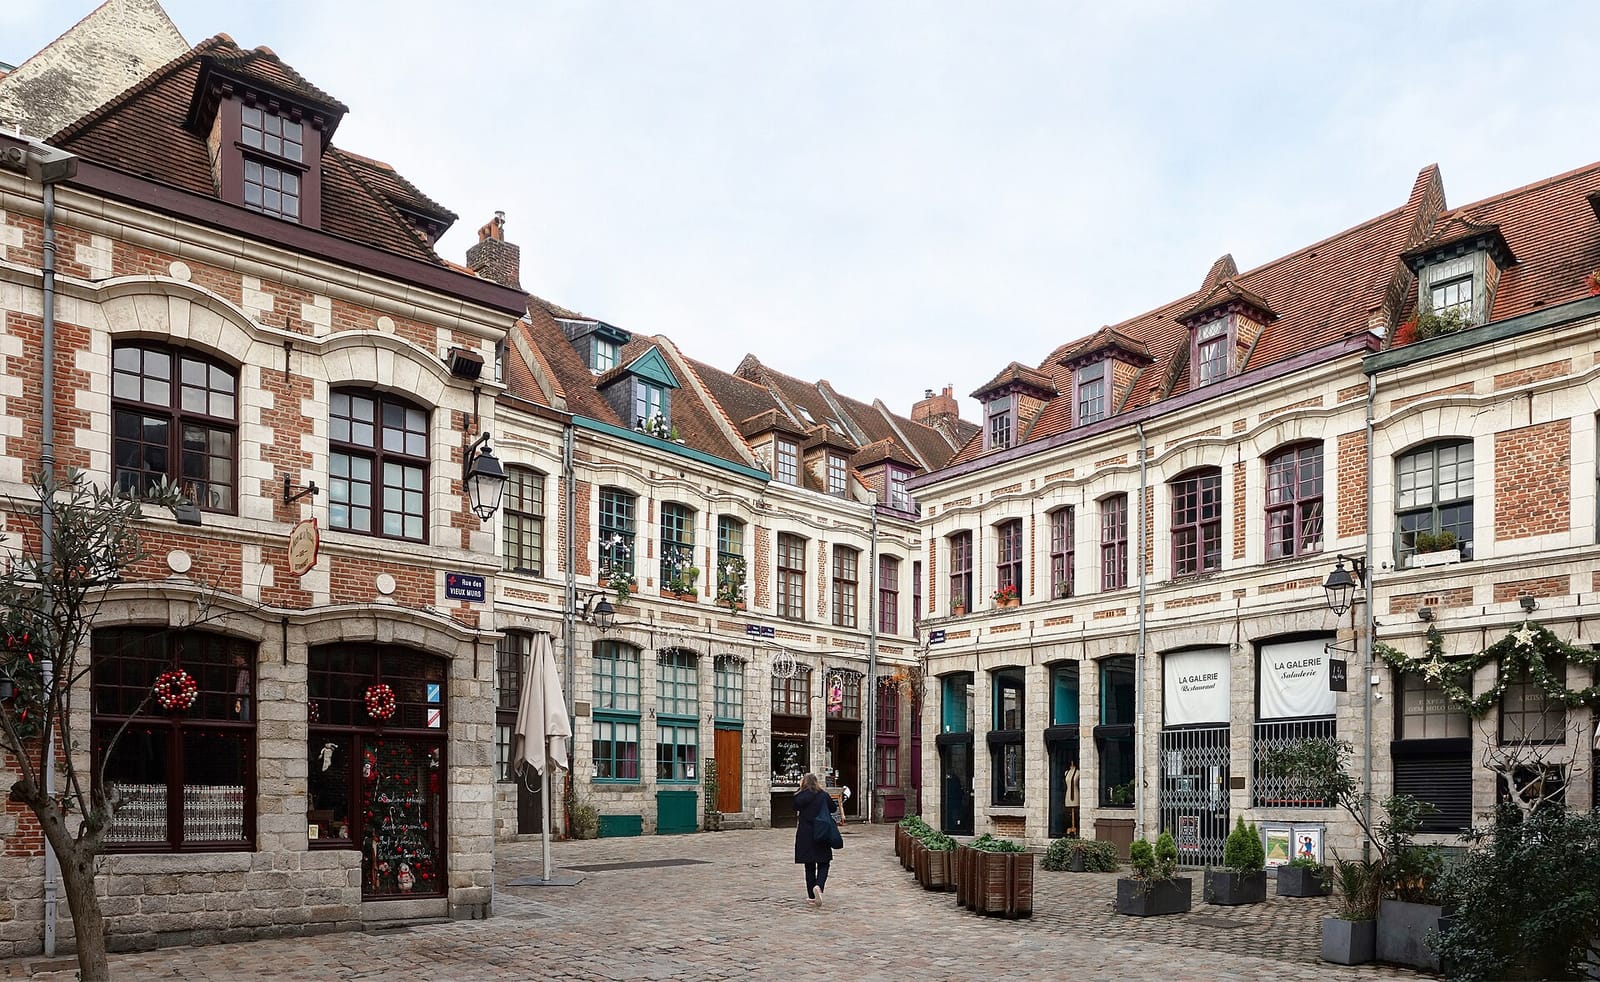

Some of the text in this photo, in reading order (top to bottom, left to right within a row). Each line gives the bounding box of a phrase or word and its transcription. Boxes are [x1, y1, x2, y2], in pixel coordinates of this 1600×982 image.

[461, 579, 482, 588] Rue des
[450, 588, 481, 597] VIEUX MURS
[1274, 658, 1322, 671] LA GALERIE
[1178, 673, 1218, 685] LA GALERIE
[1280, 669, 1317, 680] Saladerie
